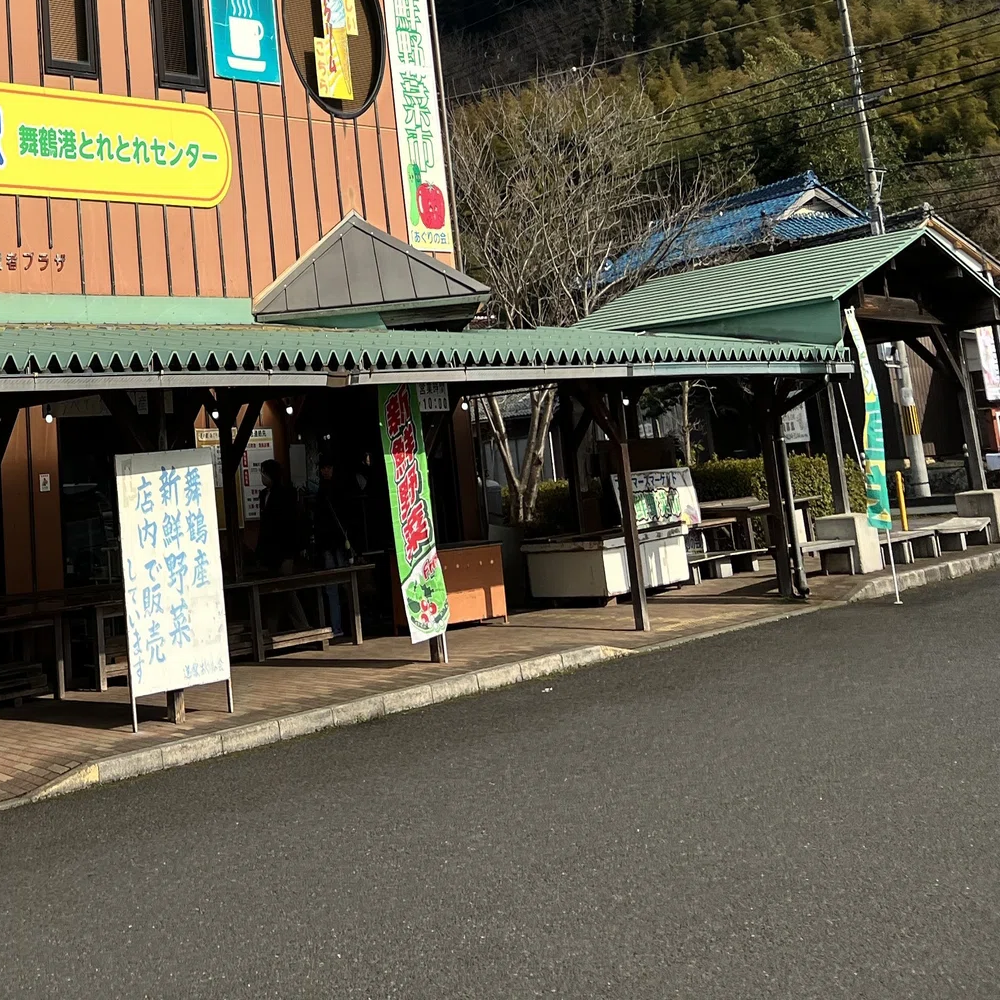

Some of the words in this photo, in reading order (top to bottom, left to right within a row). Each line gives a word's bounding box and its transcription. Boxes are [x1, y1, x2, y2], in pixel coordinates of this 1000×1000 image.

[315, 41, 328, 94] こちら
[18, 124, 218, 169] 舞鶴港とれとれセンター
[184, 466, 211, 589] 舞鶴産
[386, 384, 430, 561] 新鮮野菜
[136, 476, 166, 665] 店内で販売
[159, 465, 191, 648] 新鮮野菜
[127, 558, 145, 685] しています
